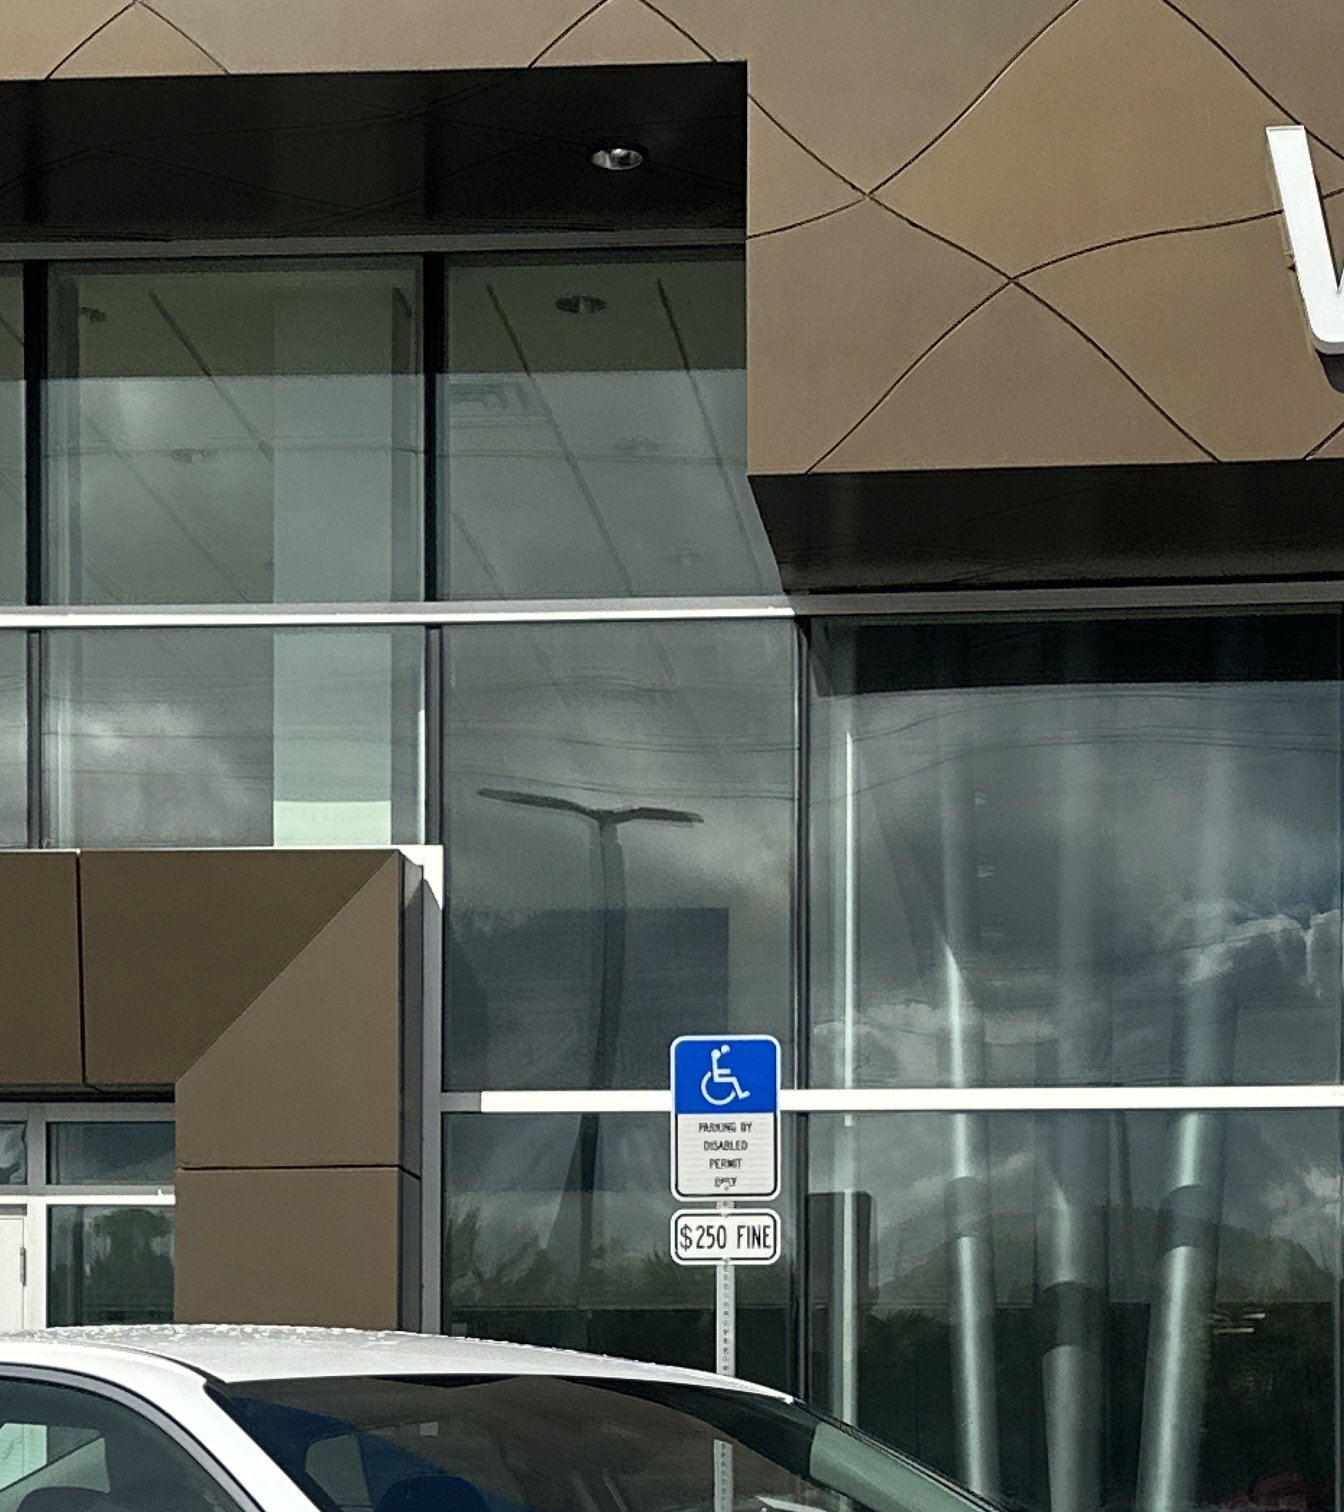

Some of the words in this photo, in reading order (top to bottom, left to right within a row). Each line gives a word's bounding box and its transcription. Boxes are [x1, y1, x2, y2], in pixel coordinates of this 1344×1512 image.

[698, 1122, 737, 1133] PARKING
[703, 1140, 748, 1151] DISABLED
[709, 1158, 743, 1169] PERMIT
[679, 1223, 727, 1251] $250
[736, 1224, 773, 1250] FINE
